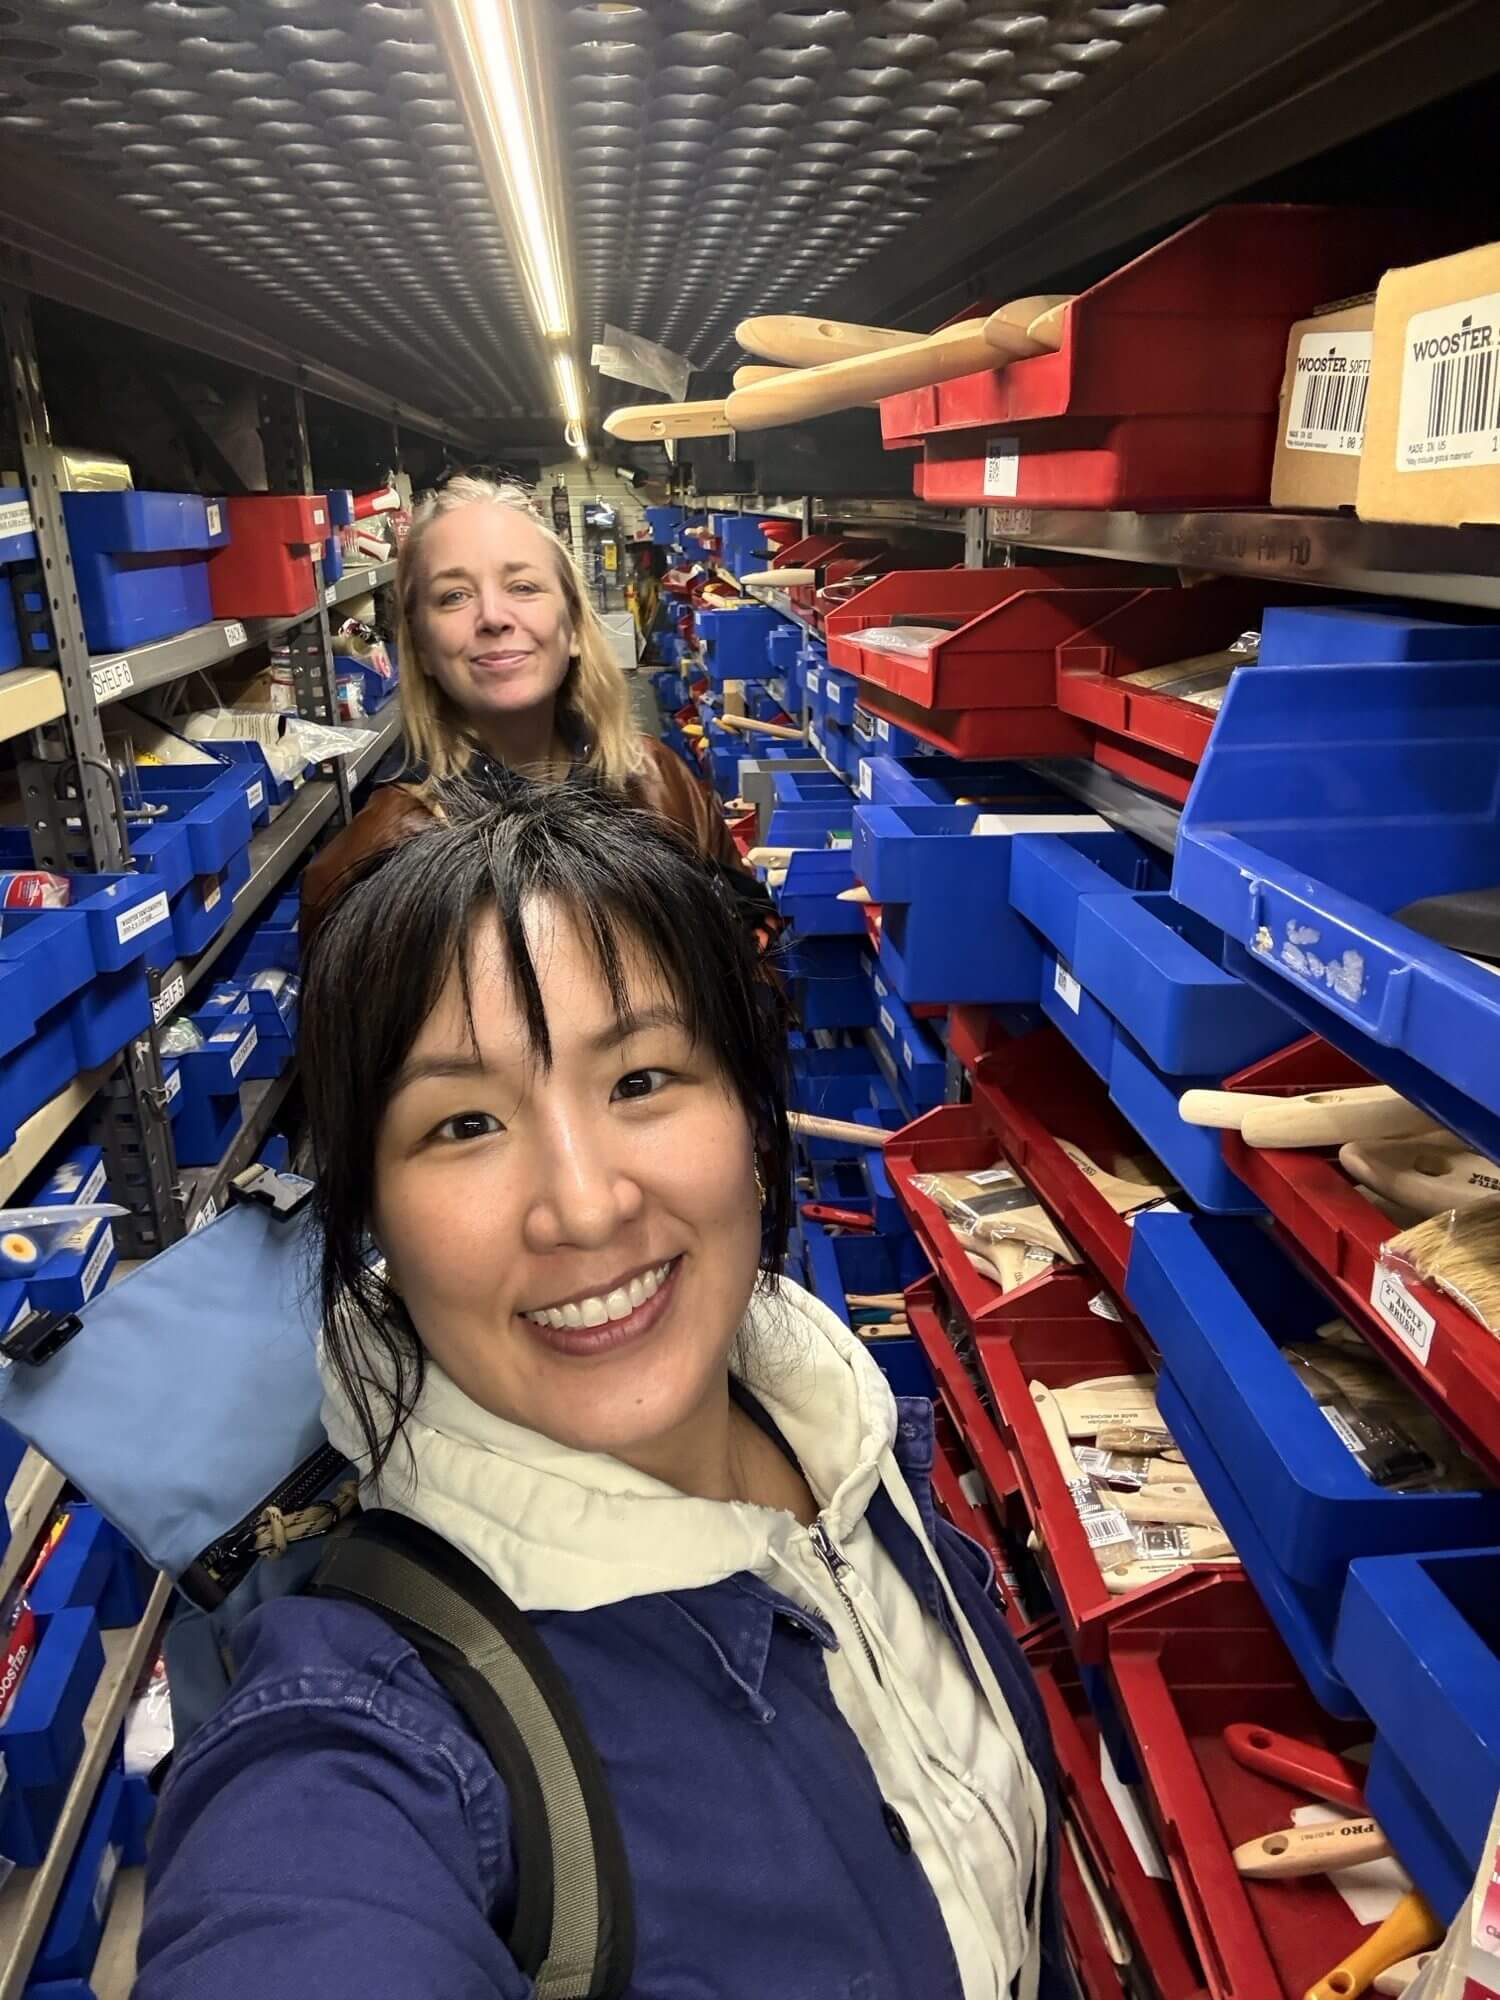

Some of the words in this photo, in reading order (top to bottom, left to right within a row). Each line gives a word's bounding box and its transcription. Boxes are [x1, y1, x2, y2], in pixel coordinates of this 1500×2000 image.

[1413, 324, 1492, 363] WOOSTER
[1298, 357, 1347, 373] WOOSTER
[92, 665, 123, 695] SHELF
[122, 662, 132, 684] 6
[153, 983, 178, 1020] SHELF
[1388, 1301, 1416, 1338] BRUSH
[1395, 1297, 1424, 1331] ANGLE
[0, 1645, 28, 1705] OOSTER
[1340, 1824, 1375, 1836] PRO
